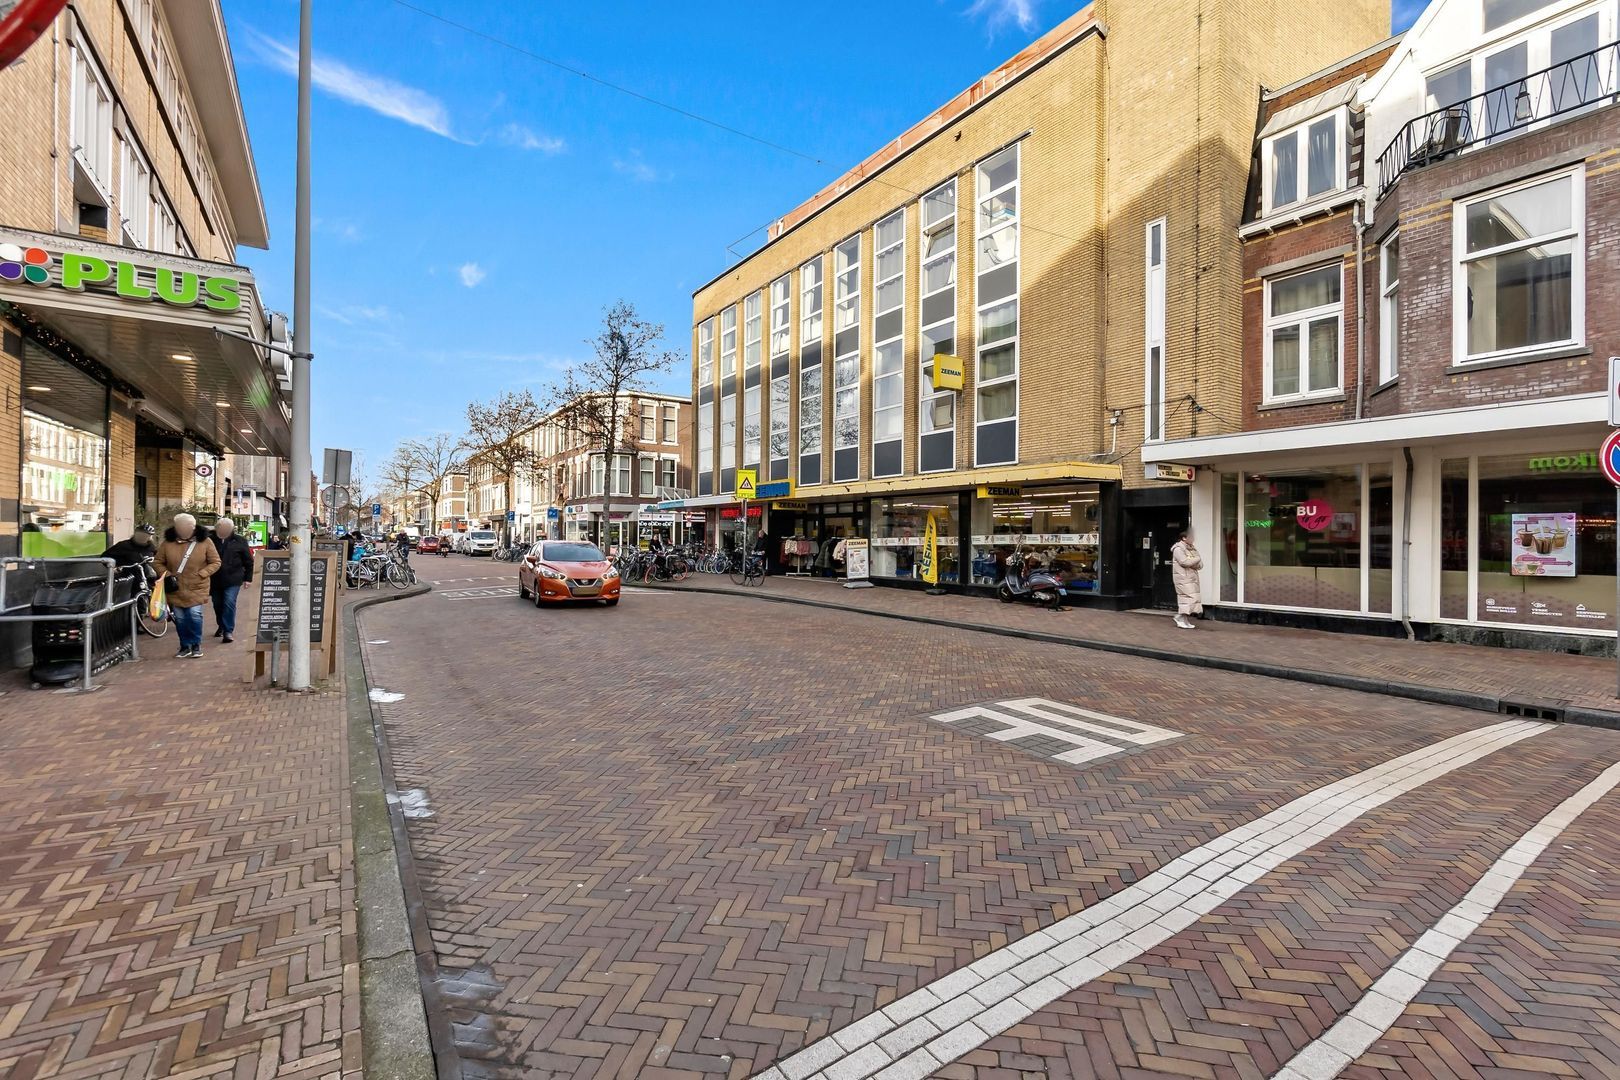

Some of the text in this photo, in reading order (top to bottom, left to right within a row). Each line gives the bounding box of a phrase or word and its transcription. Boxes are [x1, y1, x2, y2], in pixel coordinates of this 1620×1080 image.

[61, 253, 242, 311] PLUS
[941, 368, 962, 376] ZEEMAN
[988, 487, 1020, 496] ZEEMAN
